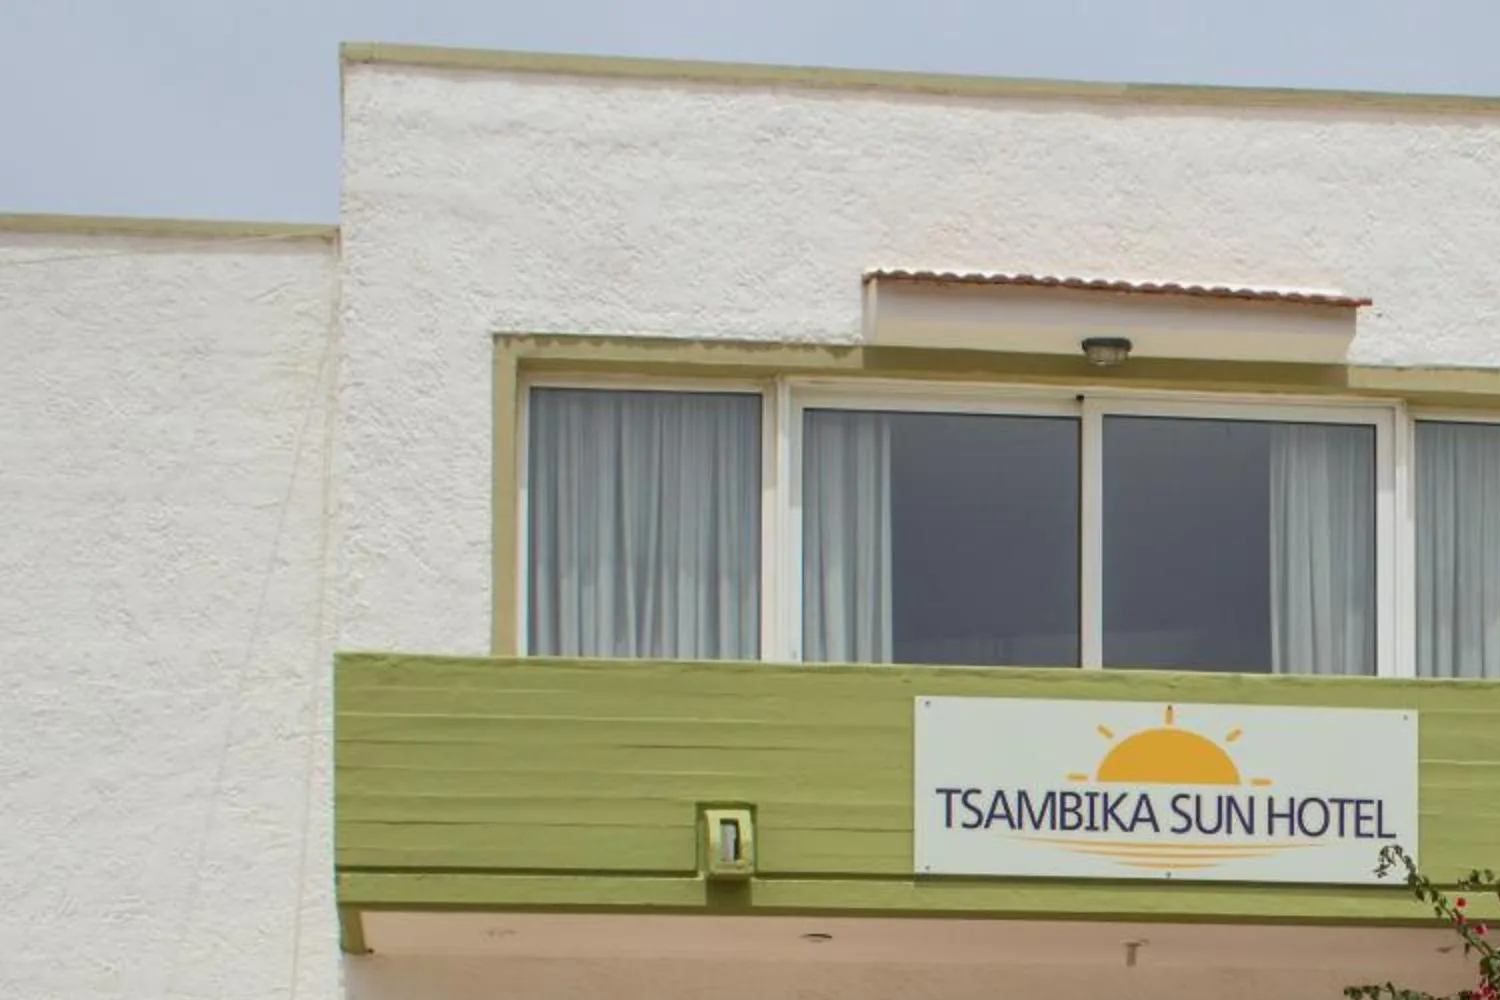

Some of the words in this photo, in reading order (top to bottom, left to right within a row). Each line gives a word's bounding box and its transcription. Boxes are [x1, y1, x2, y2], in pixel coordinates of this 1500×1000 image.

[936, 788, 1160, 834] TSAMBIKA
[1170, 793, 1254, 835] SUN
[1267, 796, 1397, 838] HOTEL
